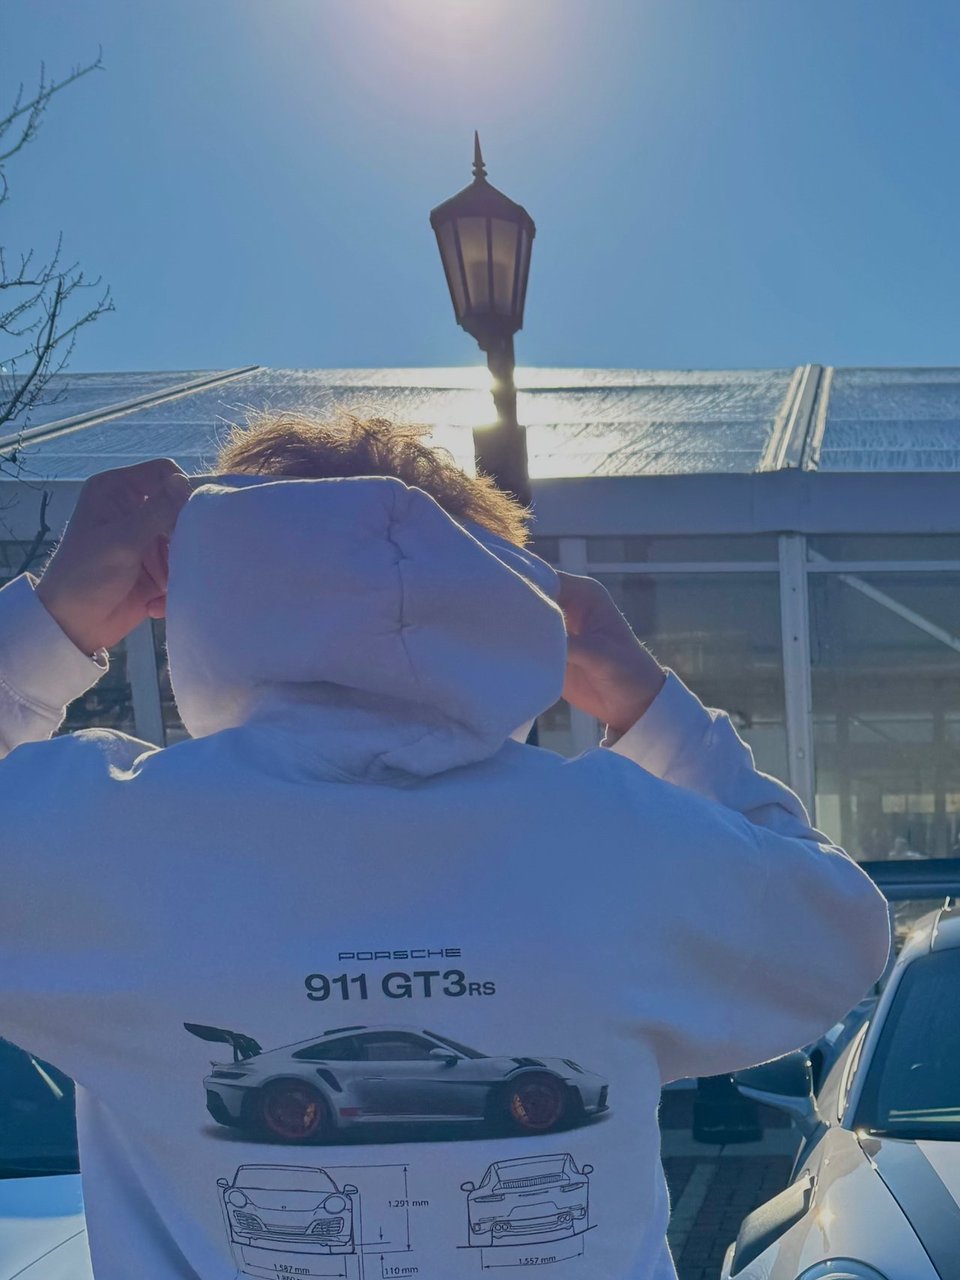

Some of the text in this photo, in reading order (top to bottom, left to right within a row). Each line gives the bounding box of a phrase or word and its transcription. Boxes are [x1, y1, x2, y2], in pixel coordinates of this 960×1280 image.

[338, 948, 461, 961] PORSCHE
[304, 973, 369, 1002] 911
[412, 1199, 430, 1207] mm
[294, 1267, 310, 1275] mm
[384, 1266, 419, 1275] 110 mm
